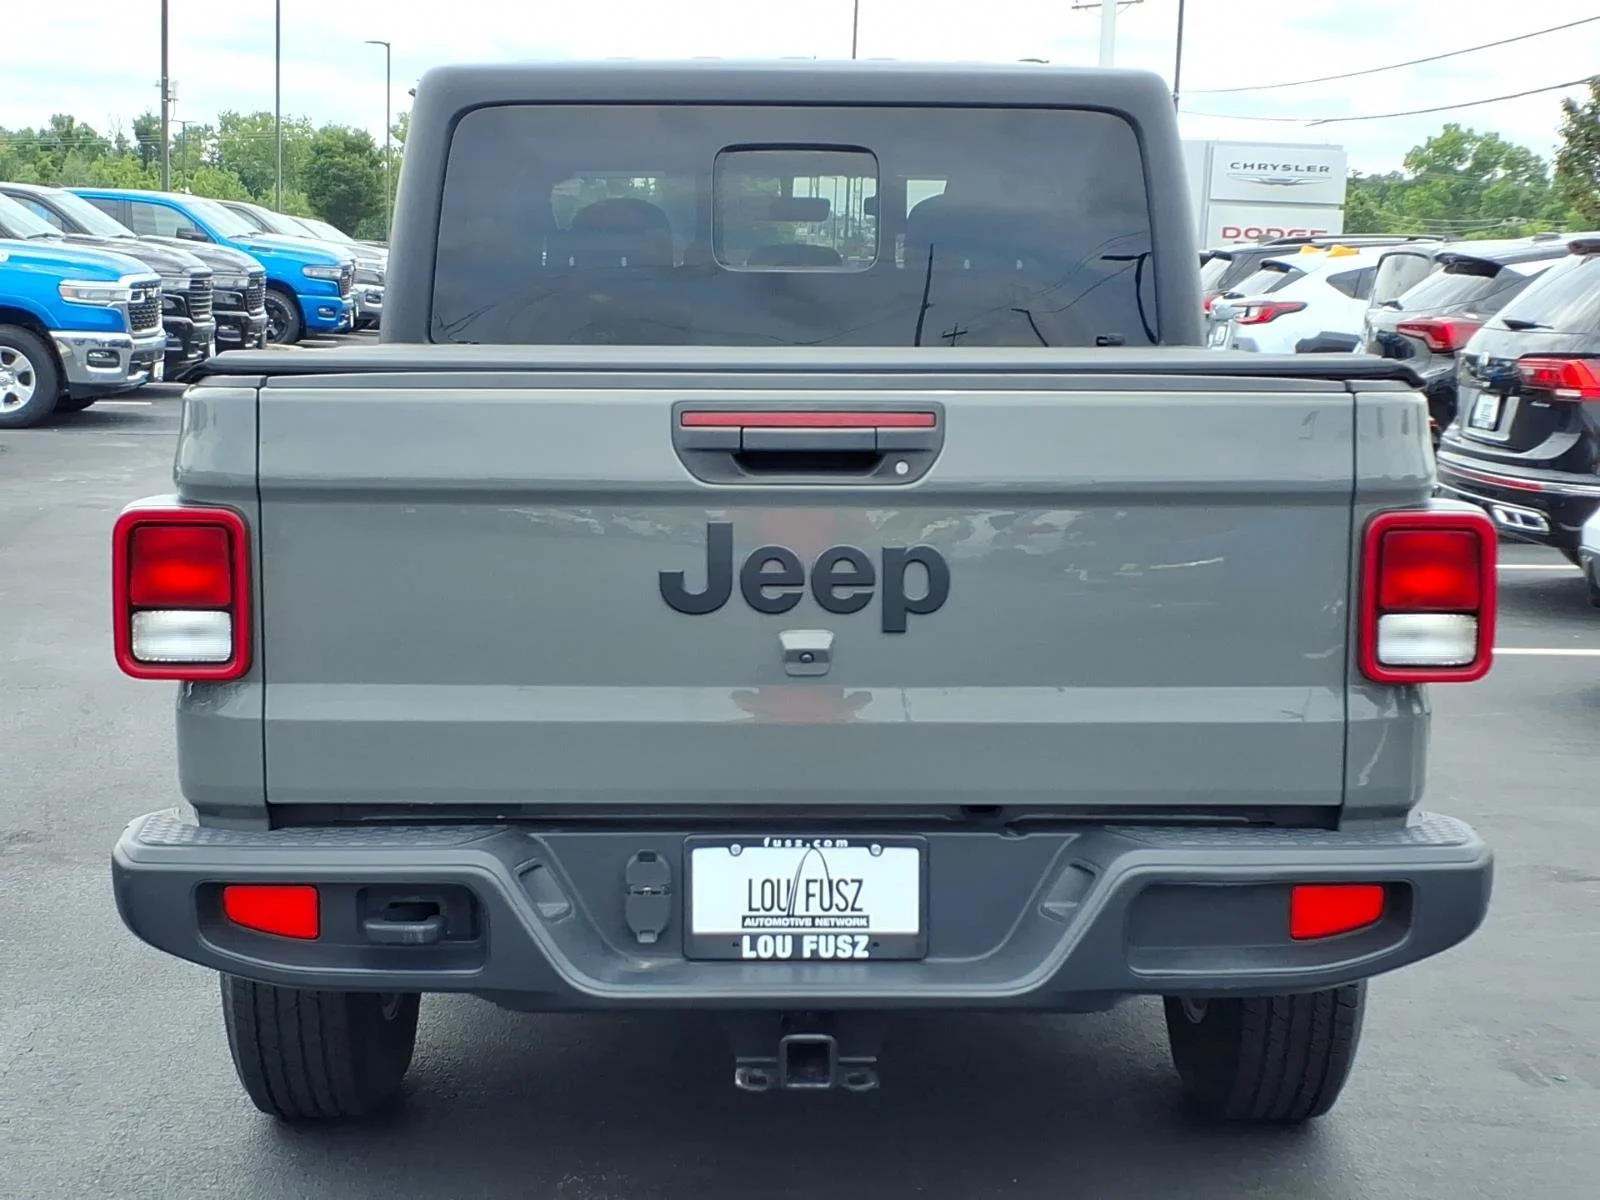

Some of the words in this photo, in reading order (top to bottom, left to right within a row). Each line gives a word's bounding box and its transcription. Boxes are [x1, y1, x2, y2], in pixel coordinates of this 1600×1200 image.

[1230, 162, 1330, 173] CHRYSLER
[658, 520, 951, 633] Jeep
[763, 837, 848, 848] fusz.com
[748, 878, 790, 912] LOU
[805, 878, 863, 912] FUSZ
[743, 917, 812, 927] AUTOMOTIVE
[814, 917, 868, 927] NETWORK
[741, 934, 793, 959] LOU
[802, 934, 870, 959] FUSZ
